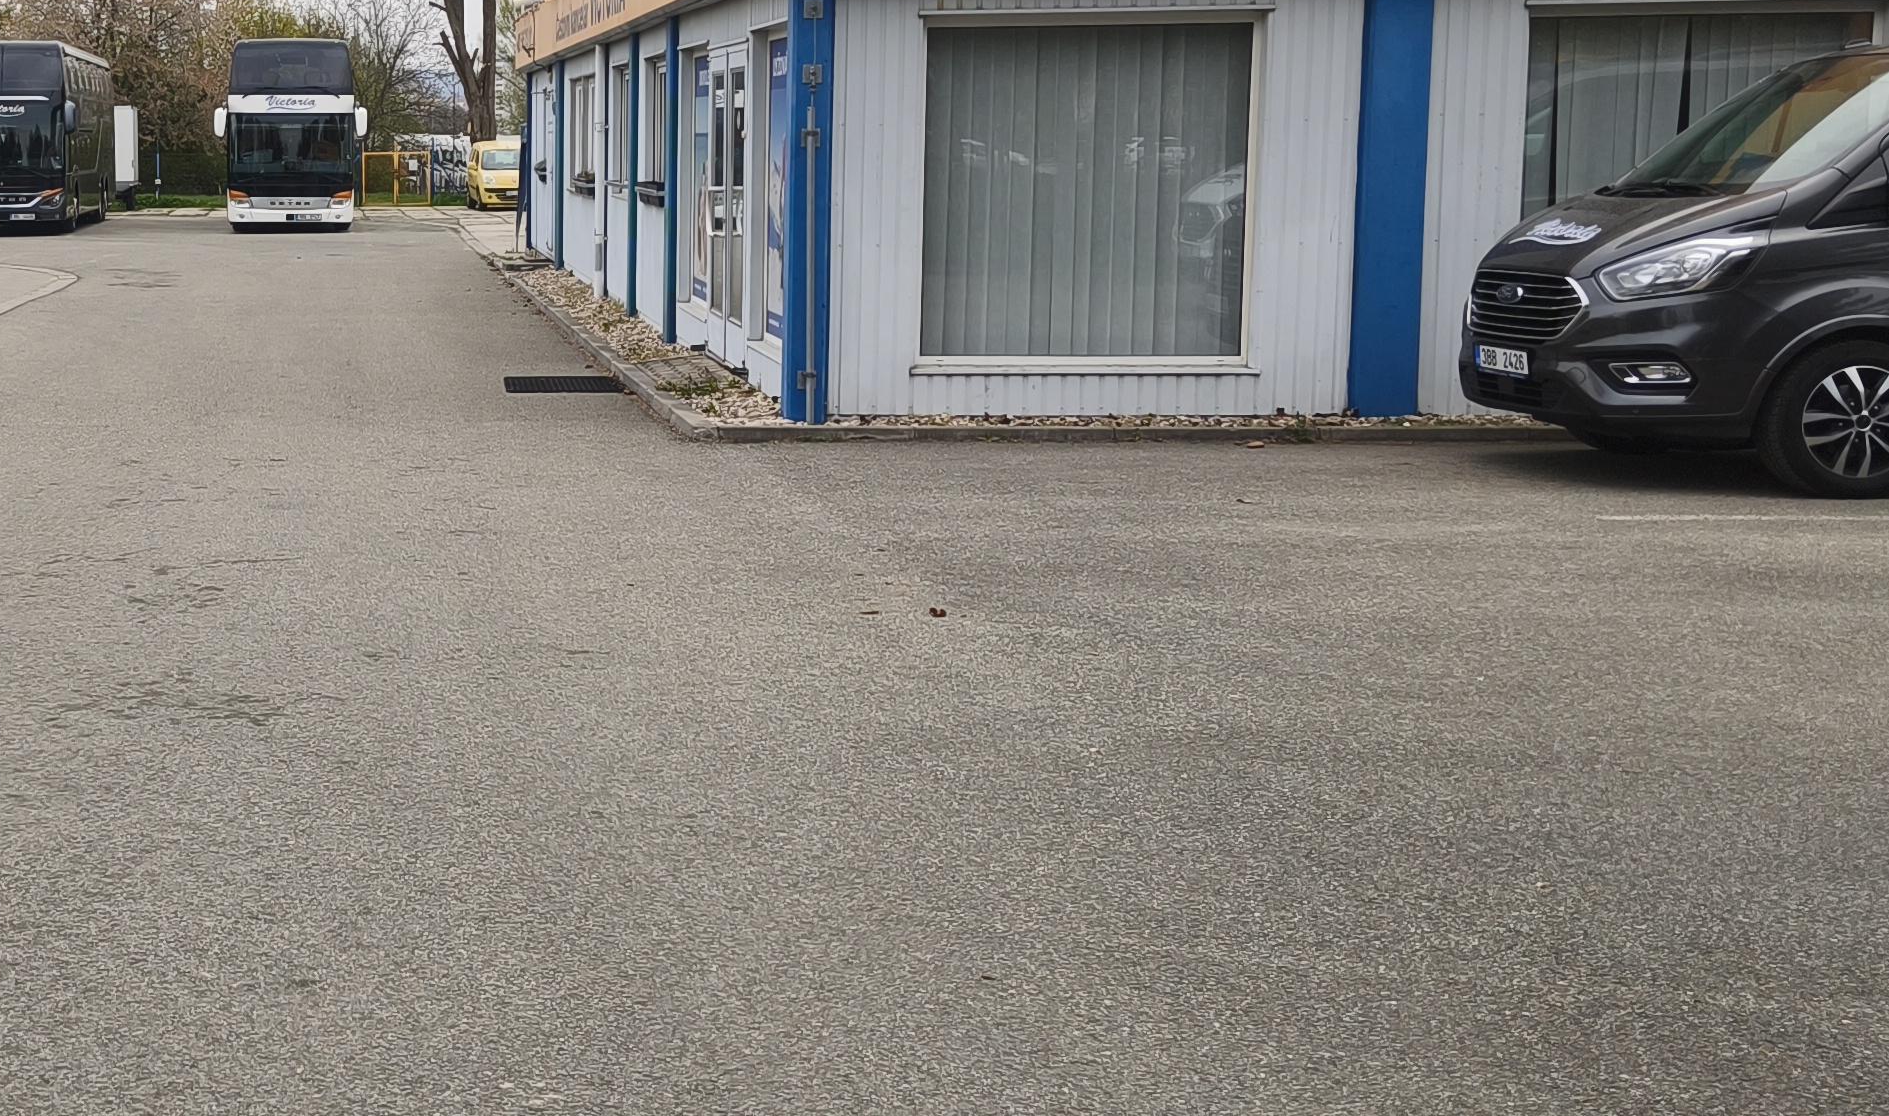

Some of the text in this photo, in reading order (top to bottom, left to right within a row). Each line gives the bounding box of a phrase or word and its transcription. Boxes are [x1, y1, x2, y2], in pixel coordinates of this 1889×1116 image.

[265, 95, 316, 106] Victoria
[1481, 347, 1525, 371] 3BB 2426
